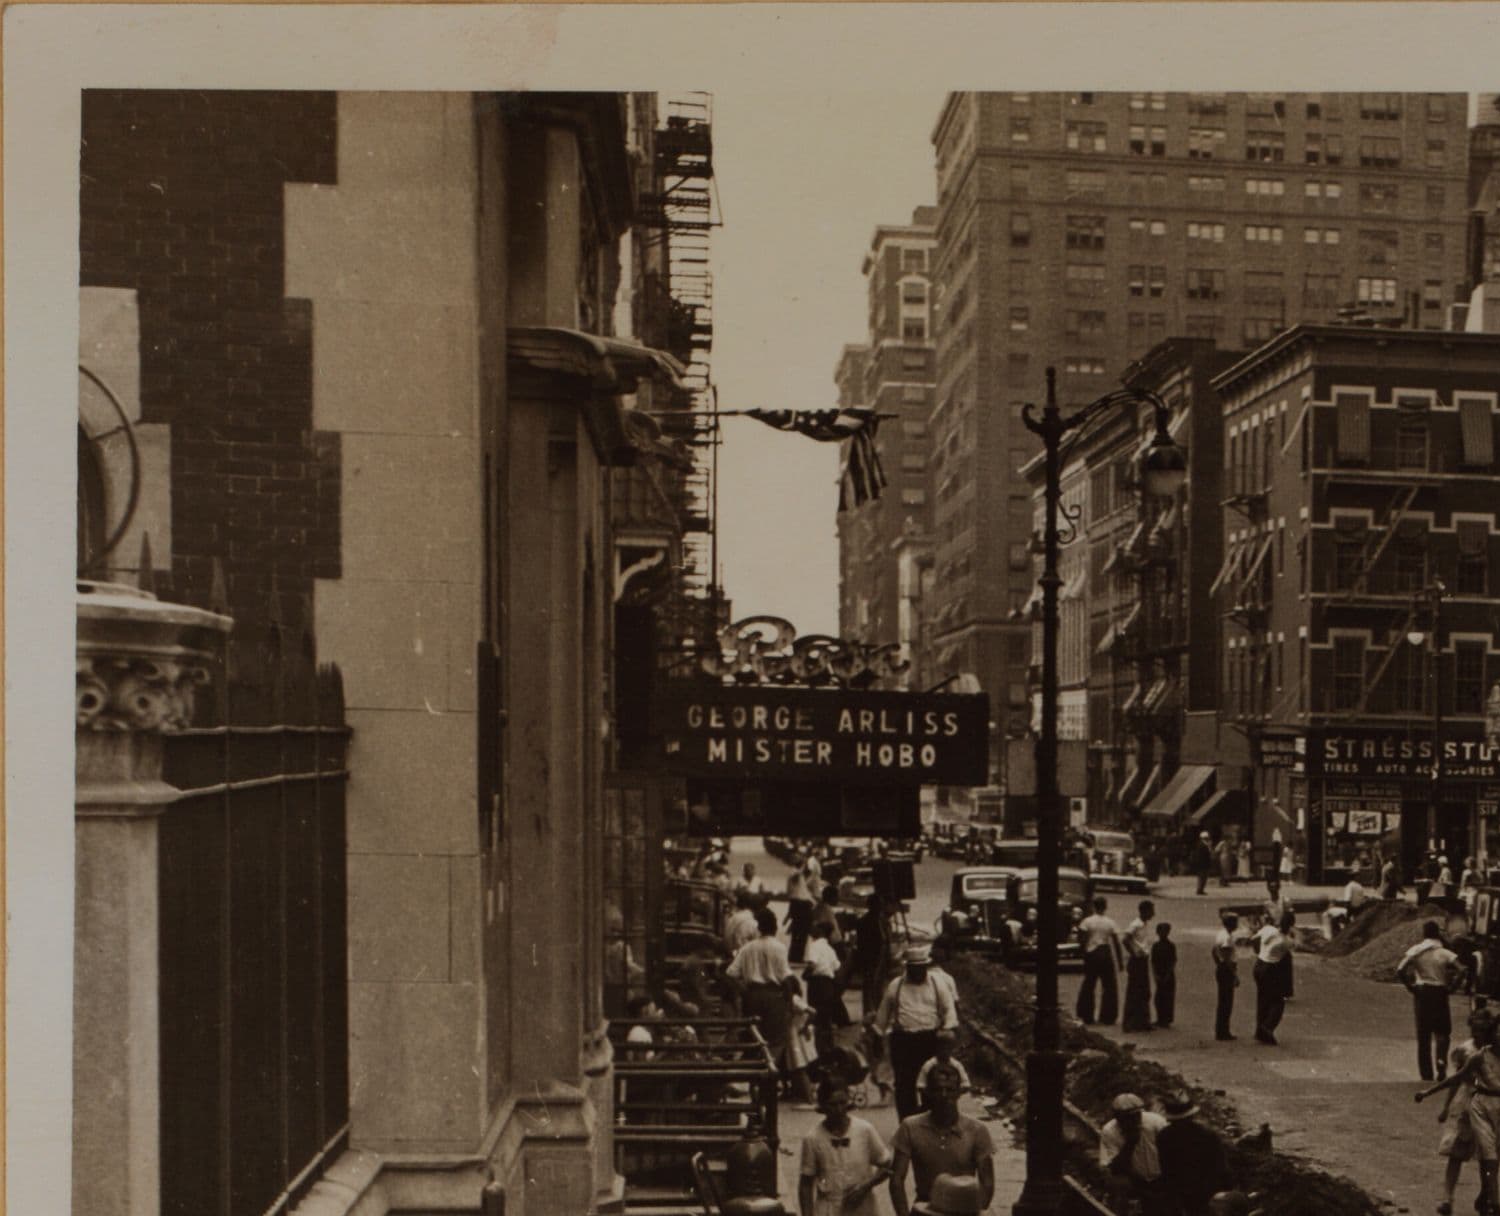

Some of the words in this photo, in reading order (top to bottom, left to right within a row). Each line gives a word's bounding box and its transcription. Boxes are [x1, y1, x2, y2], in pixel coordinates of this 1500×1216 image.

[687, 705, 814, 730] GEORGE
[838, 708, 959, 737] ARLISS
[708, 738, 833, 765] MISTER
[856, 743, 937, 768] HOBO
[1324, 762, 1360, 774] TIRES
[1376, 763, 1407, 774] AUTO
